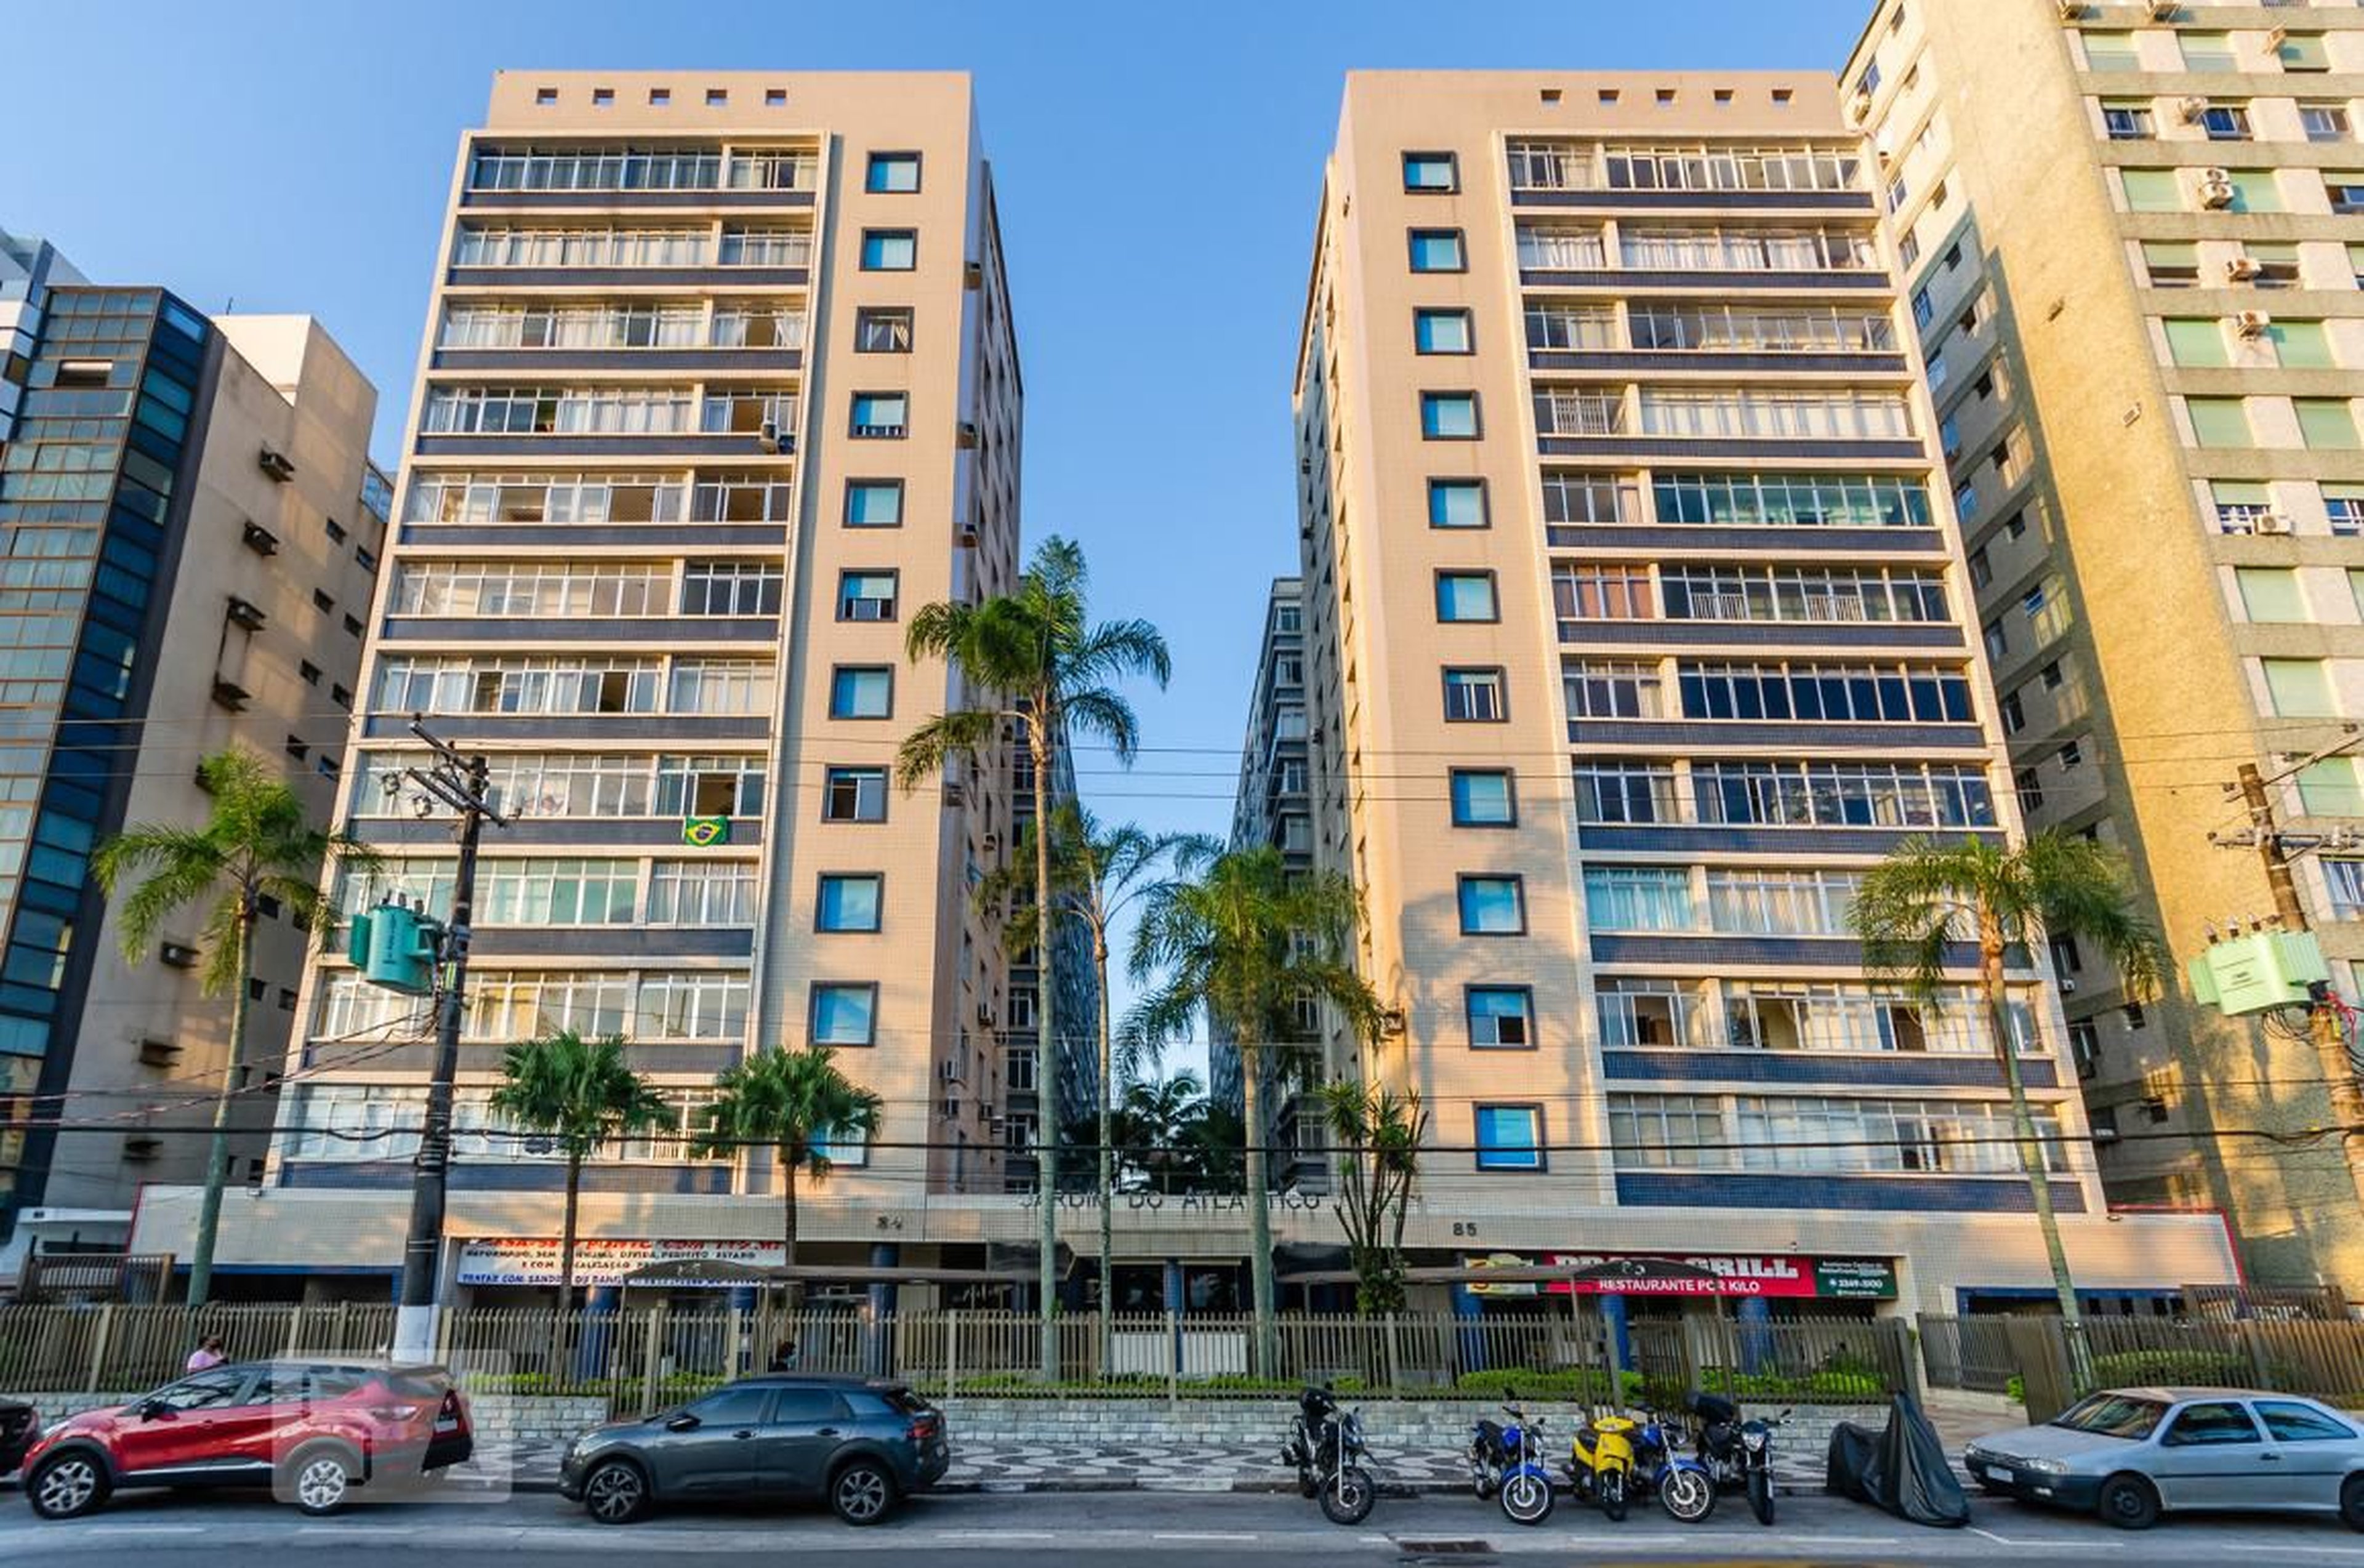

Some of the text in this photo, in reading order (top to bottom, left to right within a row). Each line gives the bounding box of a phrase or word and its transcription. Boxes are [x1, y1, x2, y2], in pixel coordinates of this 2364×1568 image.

[1128, 1189, 1163, 1209] DO
[1453, 1222, 1477, 1237] 85
[1600, 1279, 1695, 1292] RESTAURANTE
[1729, 1281, 1760, 1293] KILO
